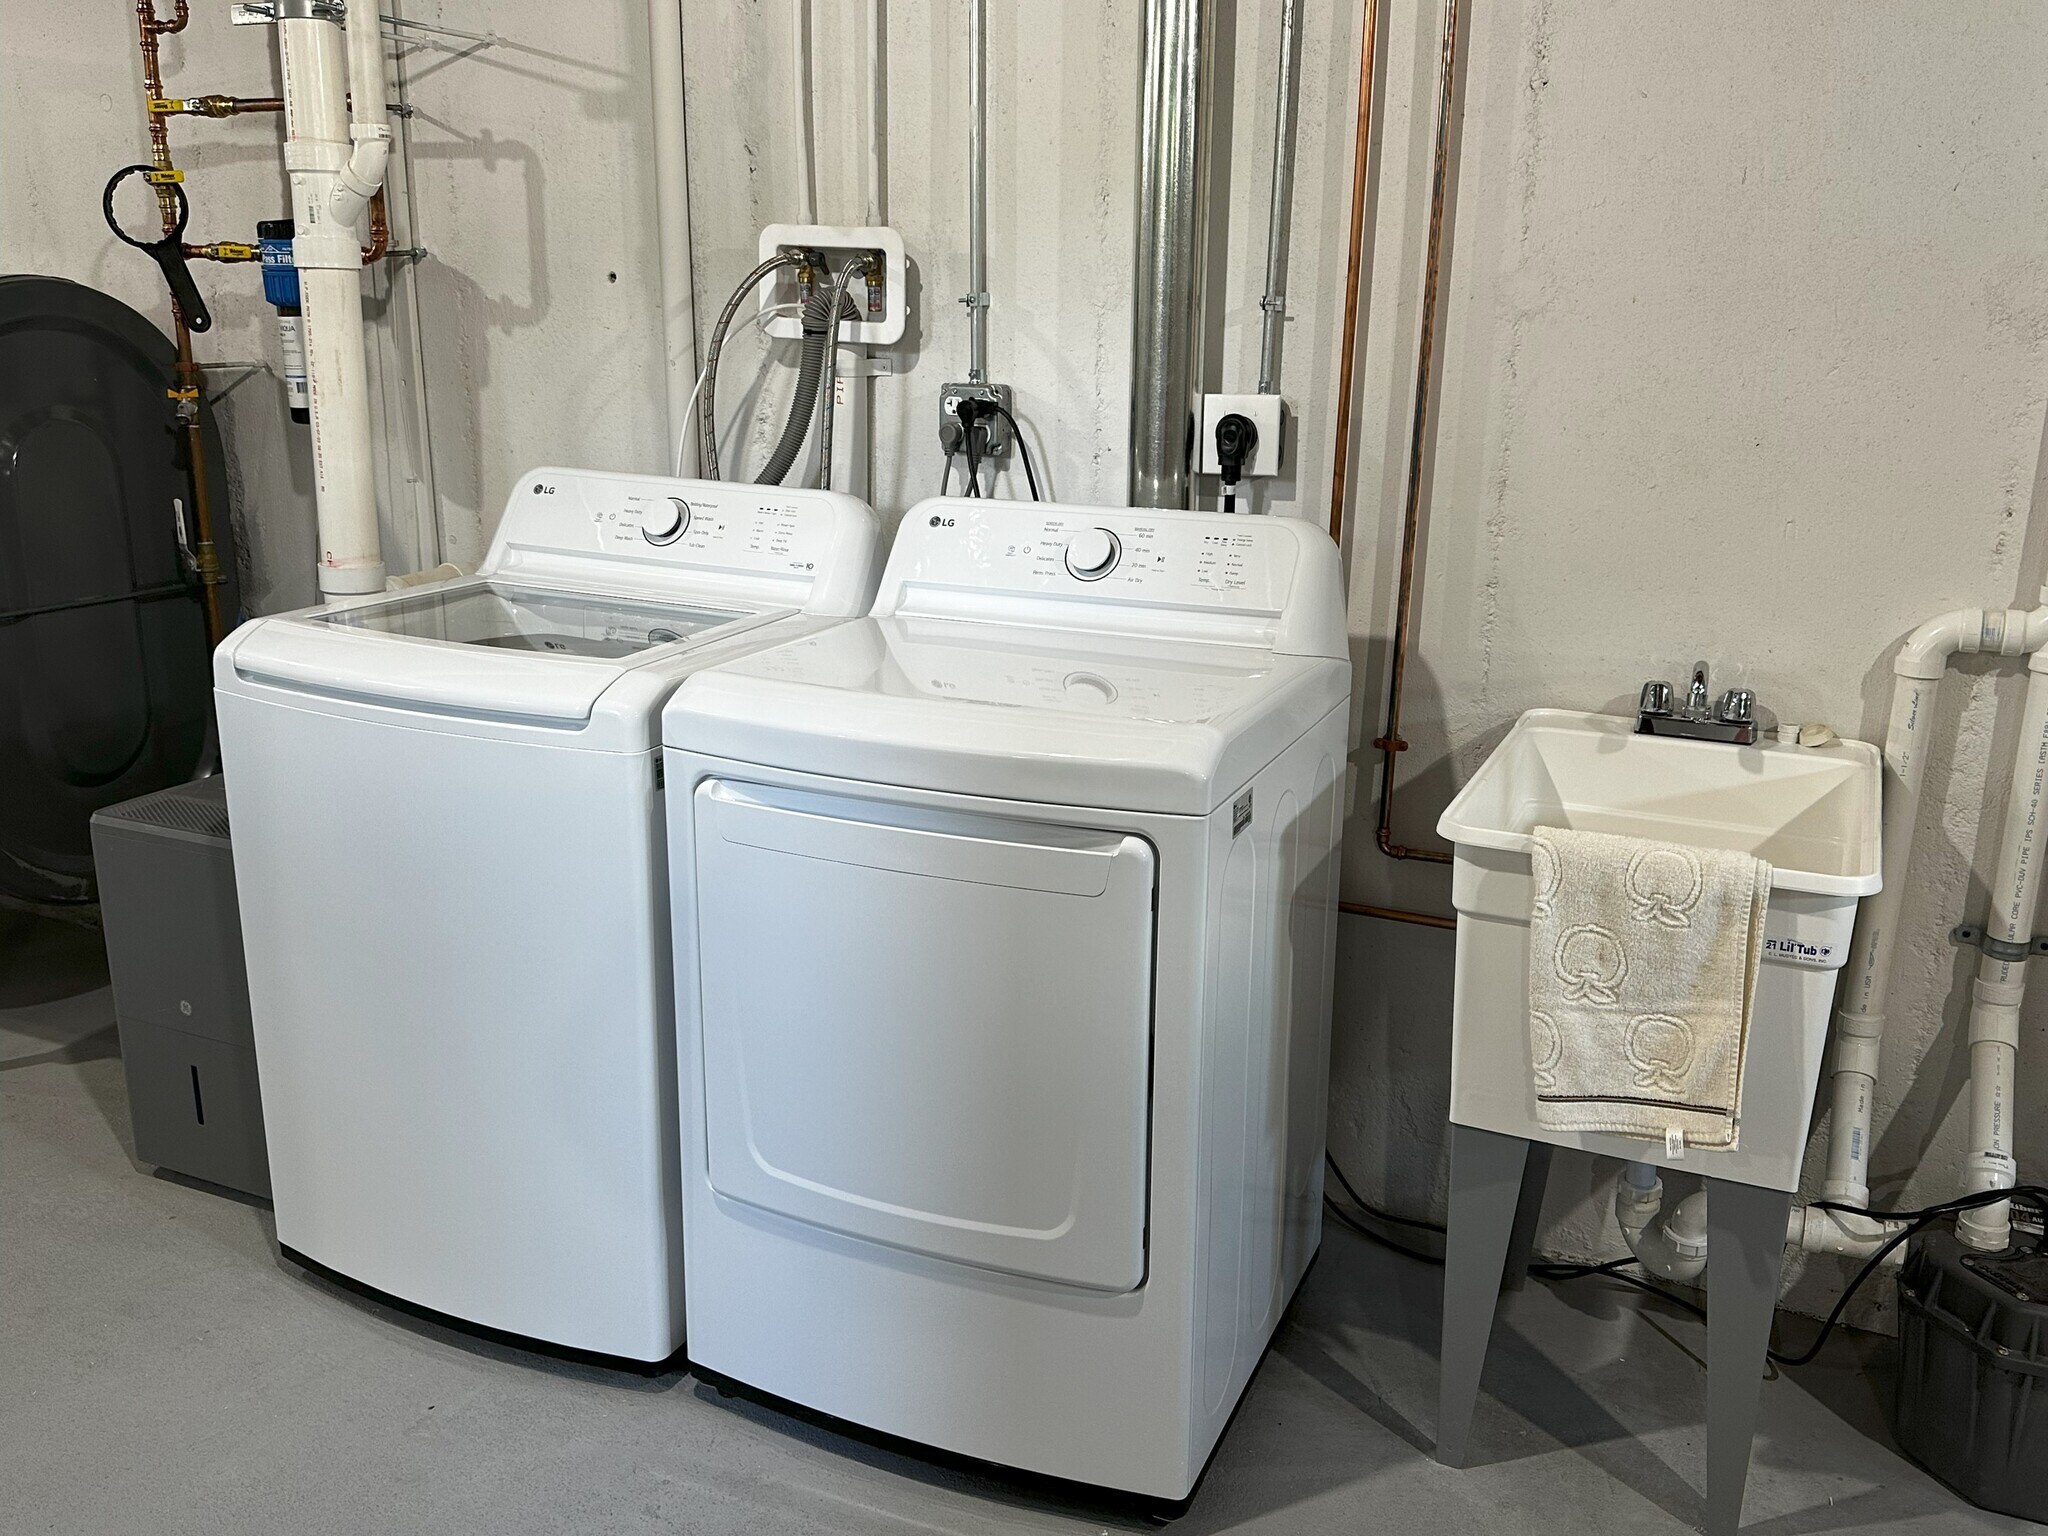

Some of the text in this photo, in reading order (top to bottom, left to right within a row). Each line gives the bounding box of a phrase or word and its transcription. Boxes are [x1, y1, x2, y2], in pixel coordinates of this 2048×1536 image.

[543, 486, 556, 495] LG
[942, 518, 955, 527] LG
[2033, 768, 2044, 795] SERIES
[2028, 799, 2038, 825] SCH-40
[2025, 829, 2033, 842] IPS
[2021, 846, 2030, 865] PIPE
[2011, 901, 2021, 920] CORE
[1864, 991, 1869, 1000] in
[1857, 1095, 1865, 1113] Made
[1993, 1102, 2001, 1136] PRESSURE
